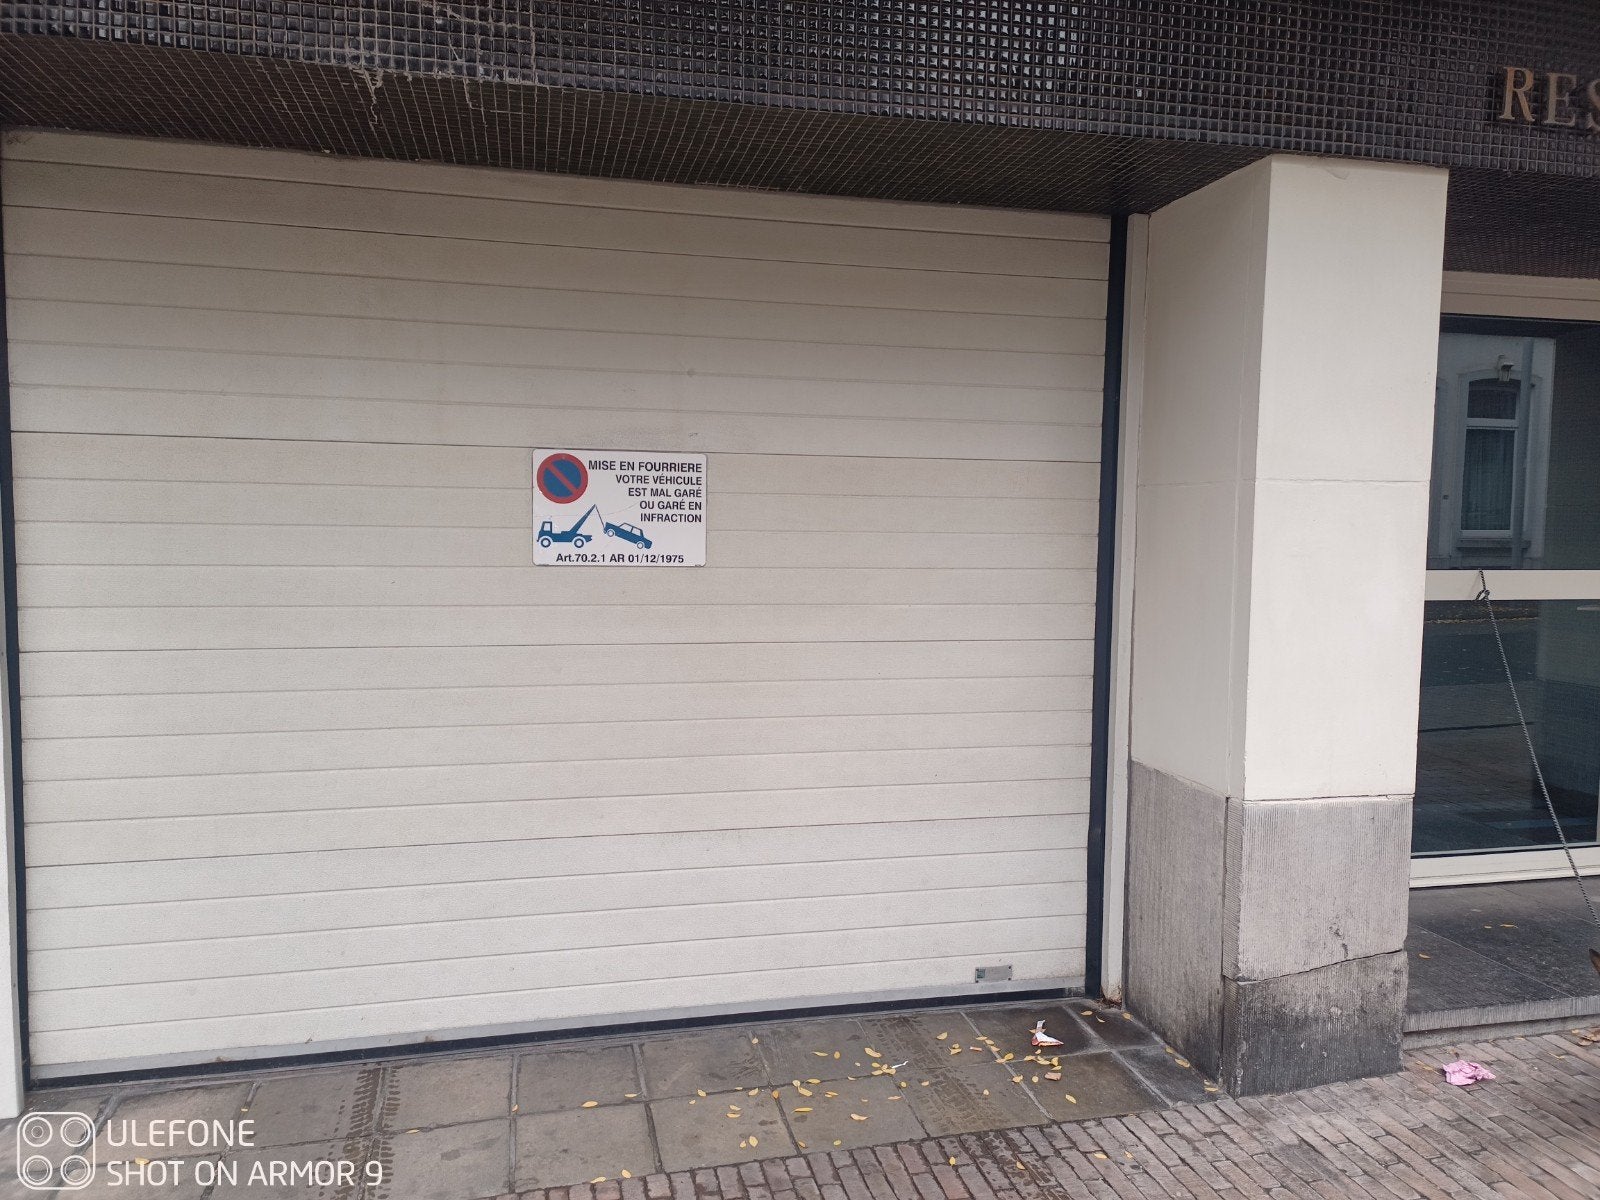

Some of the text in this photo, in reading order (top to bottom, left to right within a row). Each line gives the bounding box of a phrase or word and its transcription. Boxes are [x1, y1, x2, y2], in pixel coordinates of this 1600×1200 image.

[588, 460, 702, 473] MISE EN FOURRIERE
[615, 473, 702, 486] VOTRE VÉHICULE
[628, 487, 702, 498] EST MAL GARÉ
[639, 499, 702, 511] OU GARÉ EN
[640, 513, 702, 523] INFRACTION
[555, 553, 684, 564] Art.70.2.1 AR 01/12/1975
